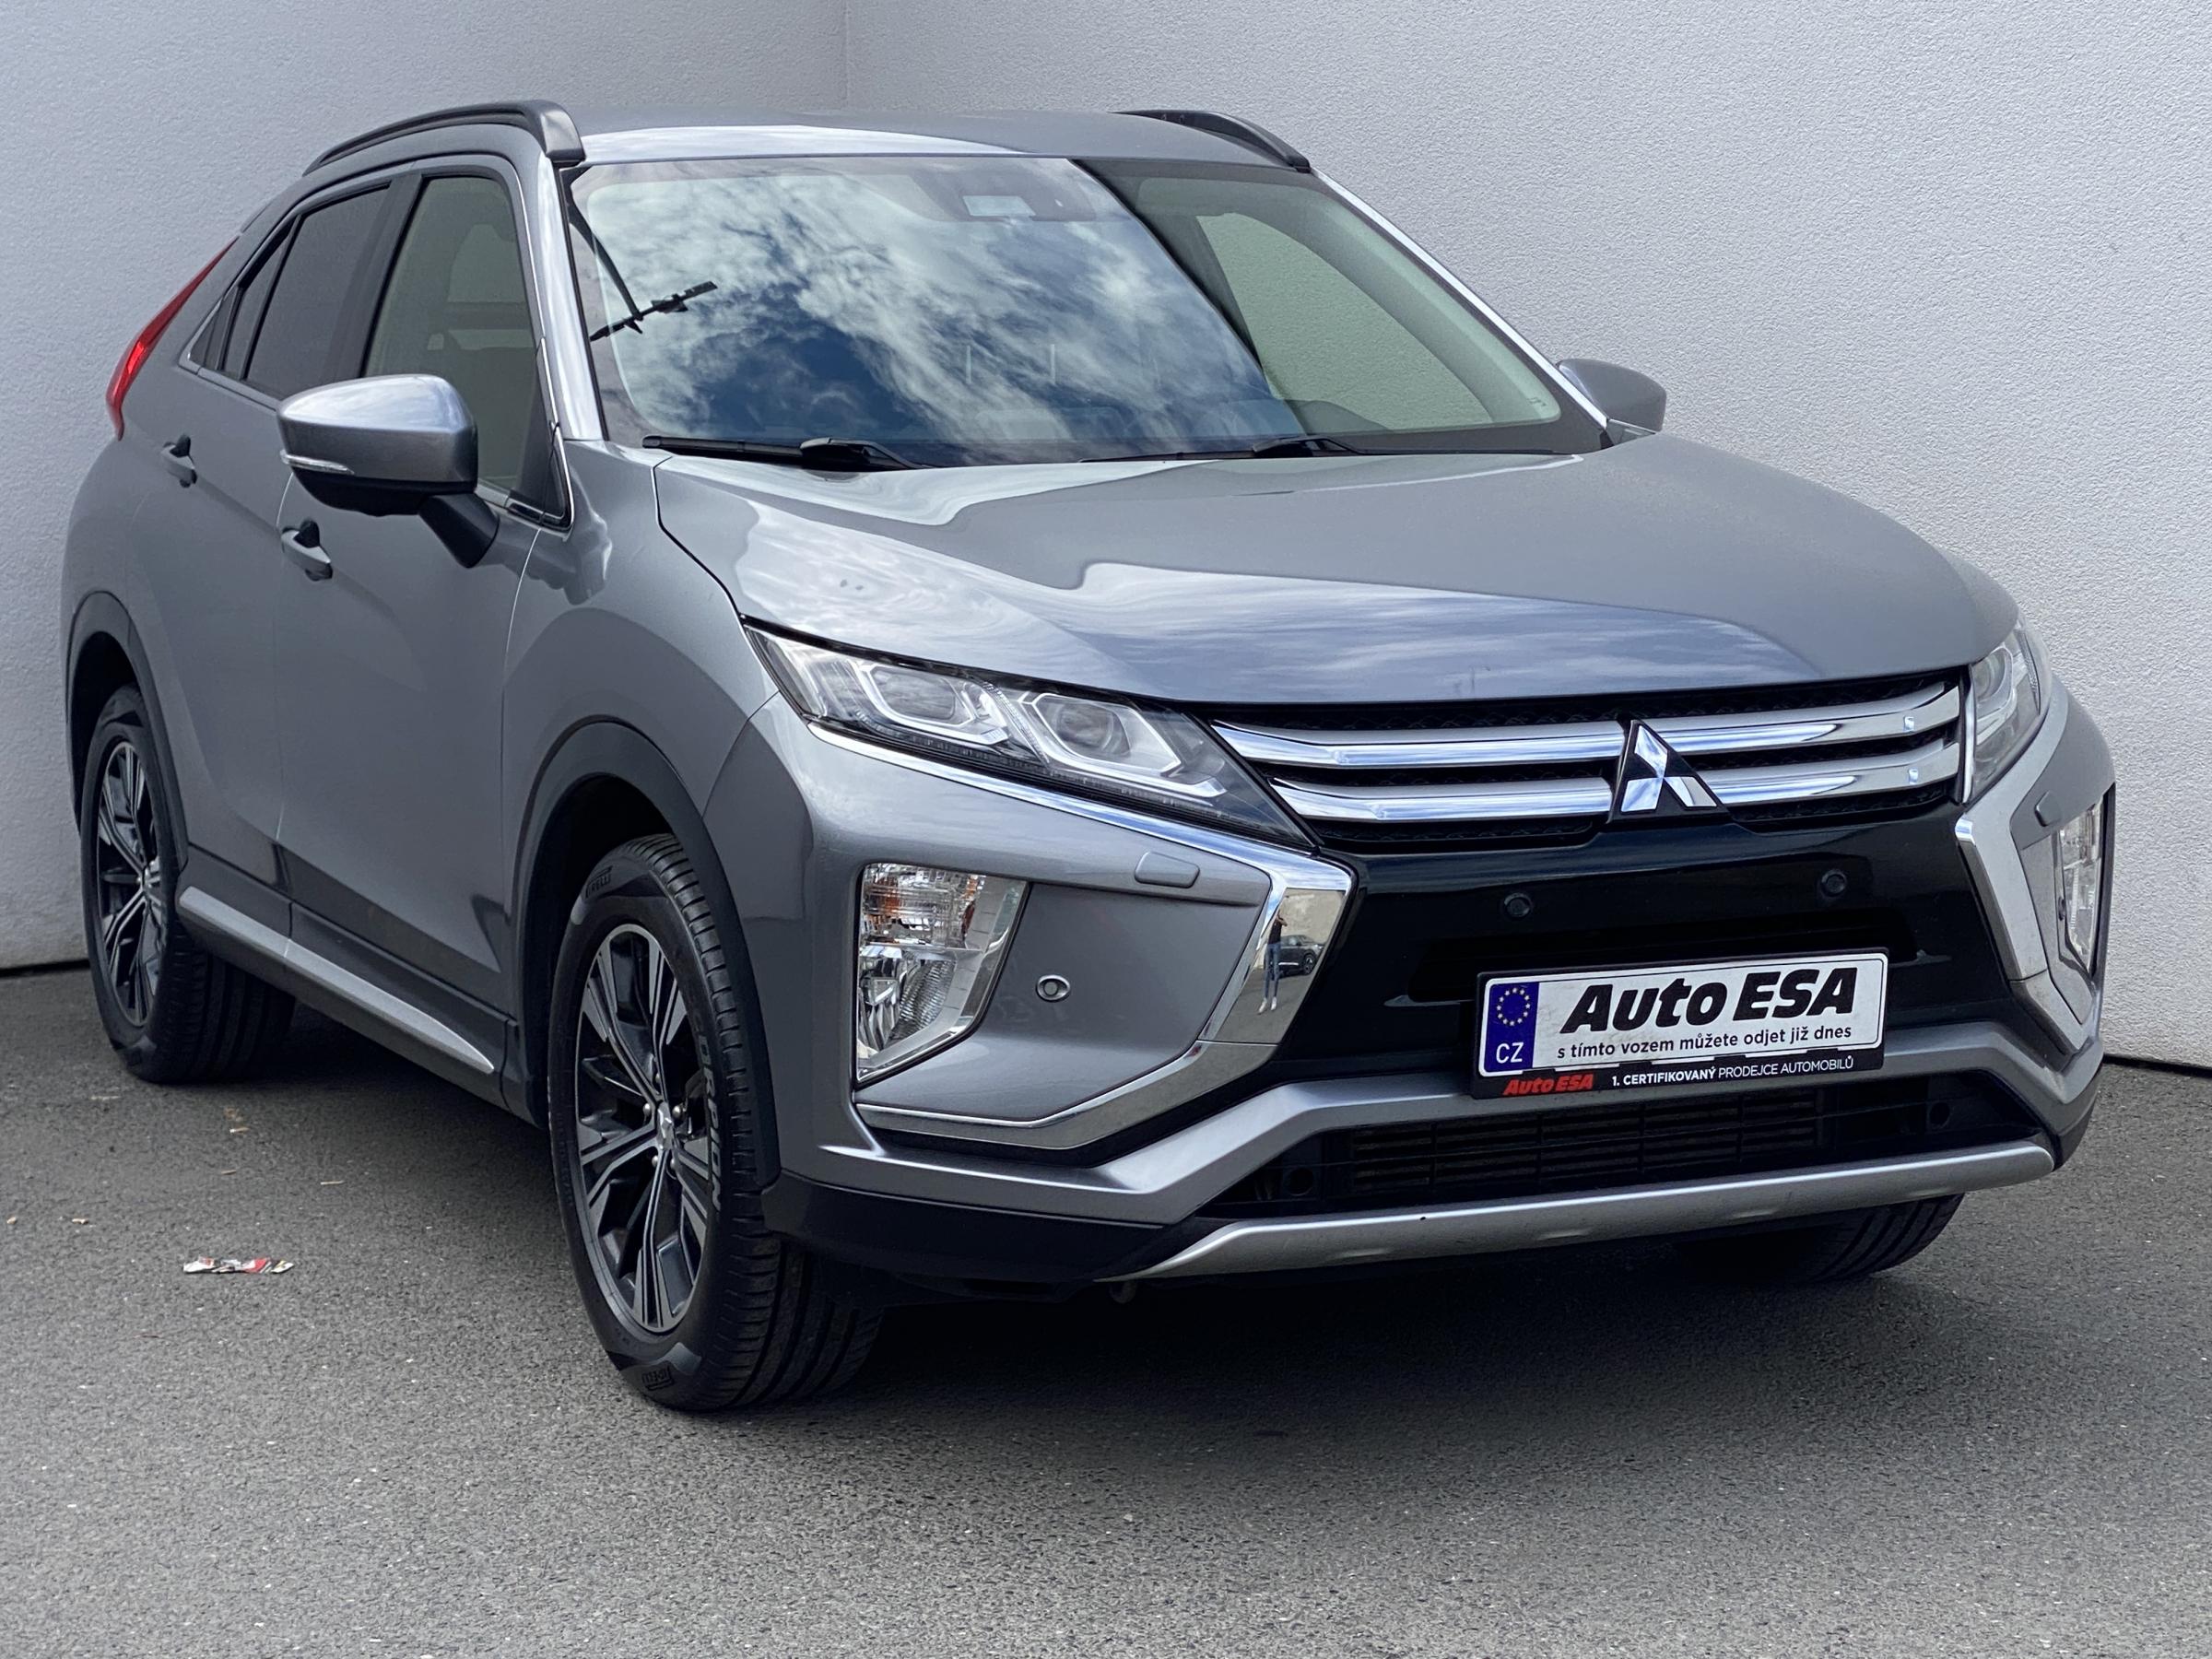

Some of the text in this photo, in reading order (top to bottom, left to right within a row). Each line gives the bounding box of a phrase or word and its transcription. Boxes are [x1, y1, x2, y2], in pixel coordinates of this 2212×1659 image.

[1559, 967, 1858, 1033] Auto ESA
[1496, 1041, 1524, 1064] CZ
[1557, 1025, 1852, 1059] s tímto vozem můžete odjet již dnes
[1502, 1073, 1594, 1096] Auto ESA
[1612, 1054, 1854, 1087] 1. CERTIFIKOVANÝ PRODEJCE AUTOMOBILŮ
